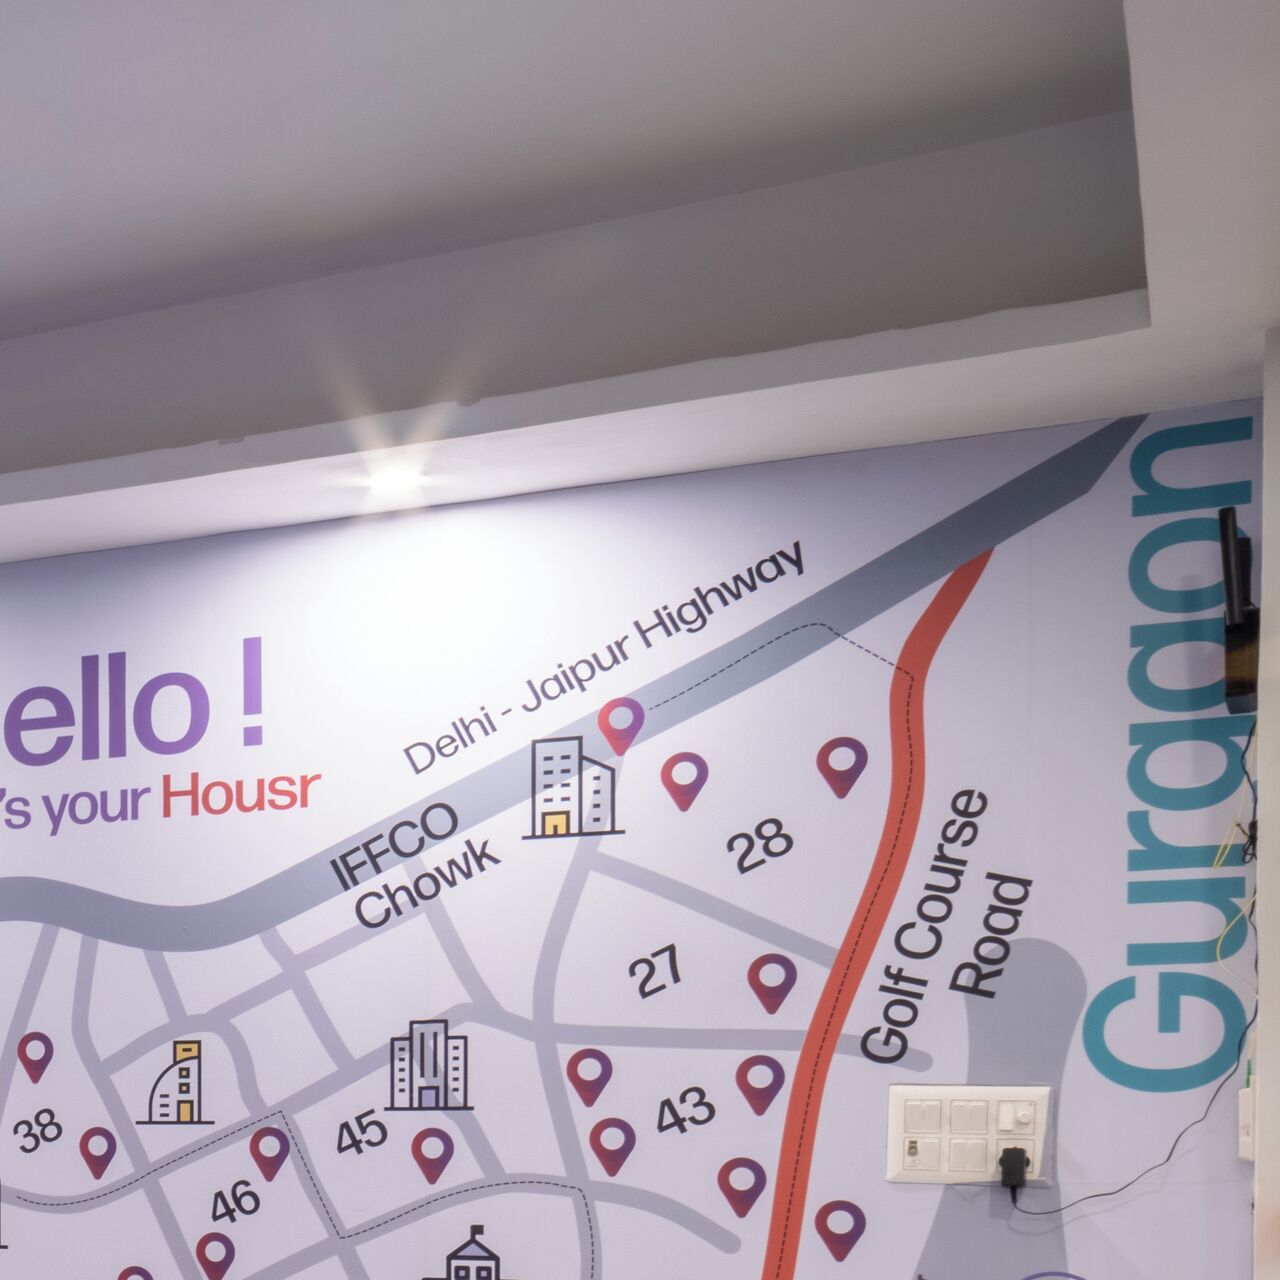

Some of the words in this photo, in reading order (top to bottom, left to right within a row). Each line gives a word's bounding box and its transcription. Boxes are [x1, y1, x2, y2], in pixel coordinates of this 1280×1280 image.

[242, 636, 263, 747] !
[402, 705, 496, 775] Delhi
[521, 633, 629, 712] Jaipur
[632, 540, 806, 649] Highway
[1082, 415, 1257, 1094] Gurgaon
[41, 783, 151, 837] your
[162, 772, 321, 818] Housr
[329, 802, 459, 892] IFFCO
[354, 837, 502, 929] Chowk
[726, 817, 794, 875] 28
[860, 963, 928, 1065] Golf
[894, 789, 988, 960] Course
[949, 872, 1033, 998] Road
[628, 943, 683, 999] 27
[13, 1108, 63, 1153] 38
[336, 1109, 388, 1160] 45
[655, 1086, 716, 1136] 43
[210, 1179, 261, 1226] 46
